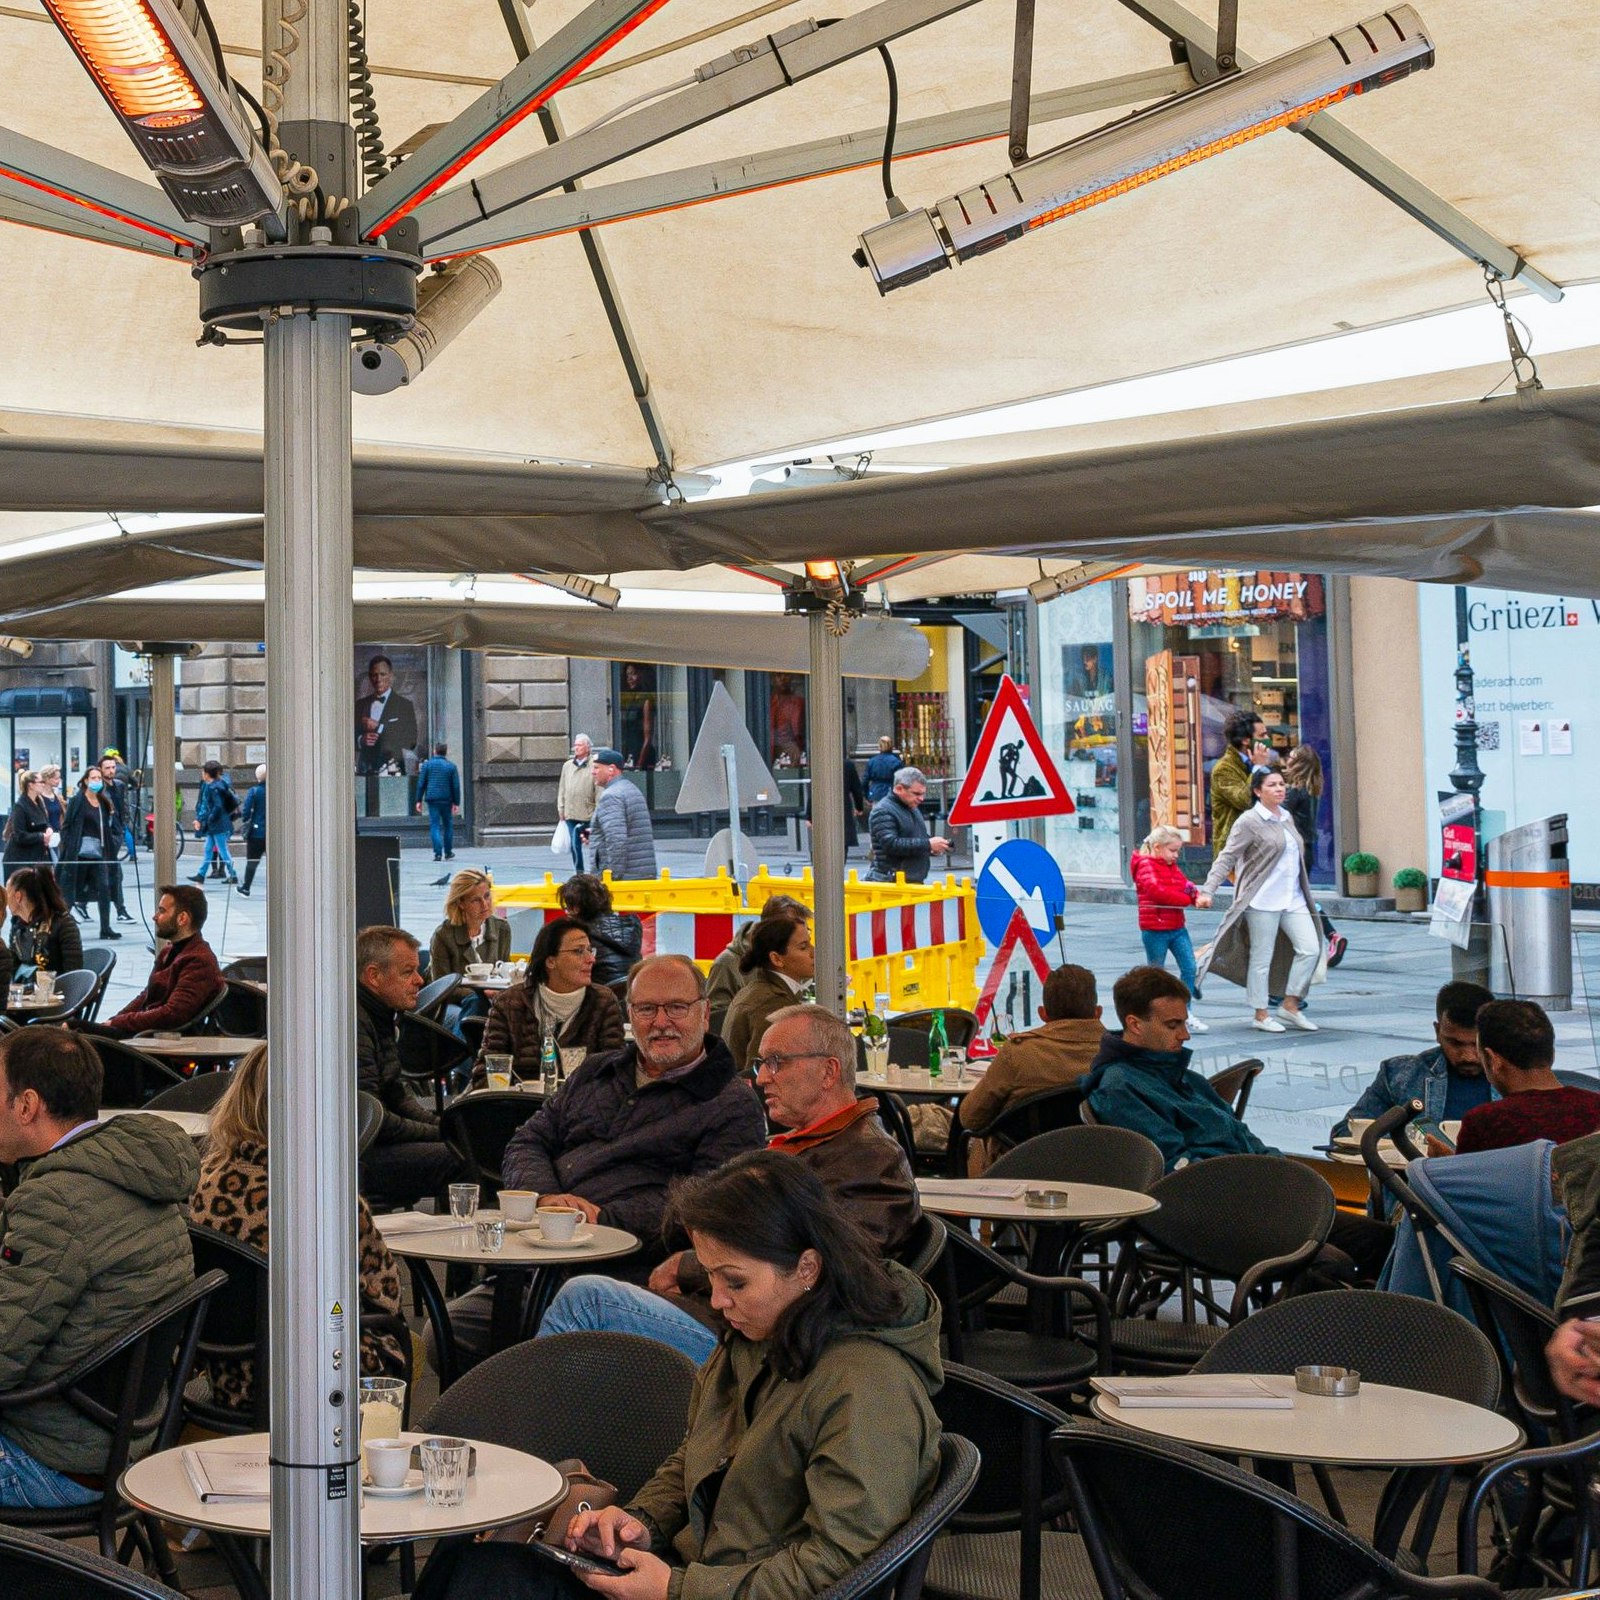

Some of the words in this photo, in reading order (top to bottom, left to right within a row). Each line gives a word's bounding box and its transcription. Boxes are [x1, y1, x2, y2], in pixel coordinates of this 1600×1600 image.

[1145, 590, 1194, 610] SPOIL
[1202, 588, 1232, 607] ME,
[1240, 581, 1308, 603] HONEY
[1468, 598, 1568, 632] Grüezi
